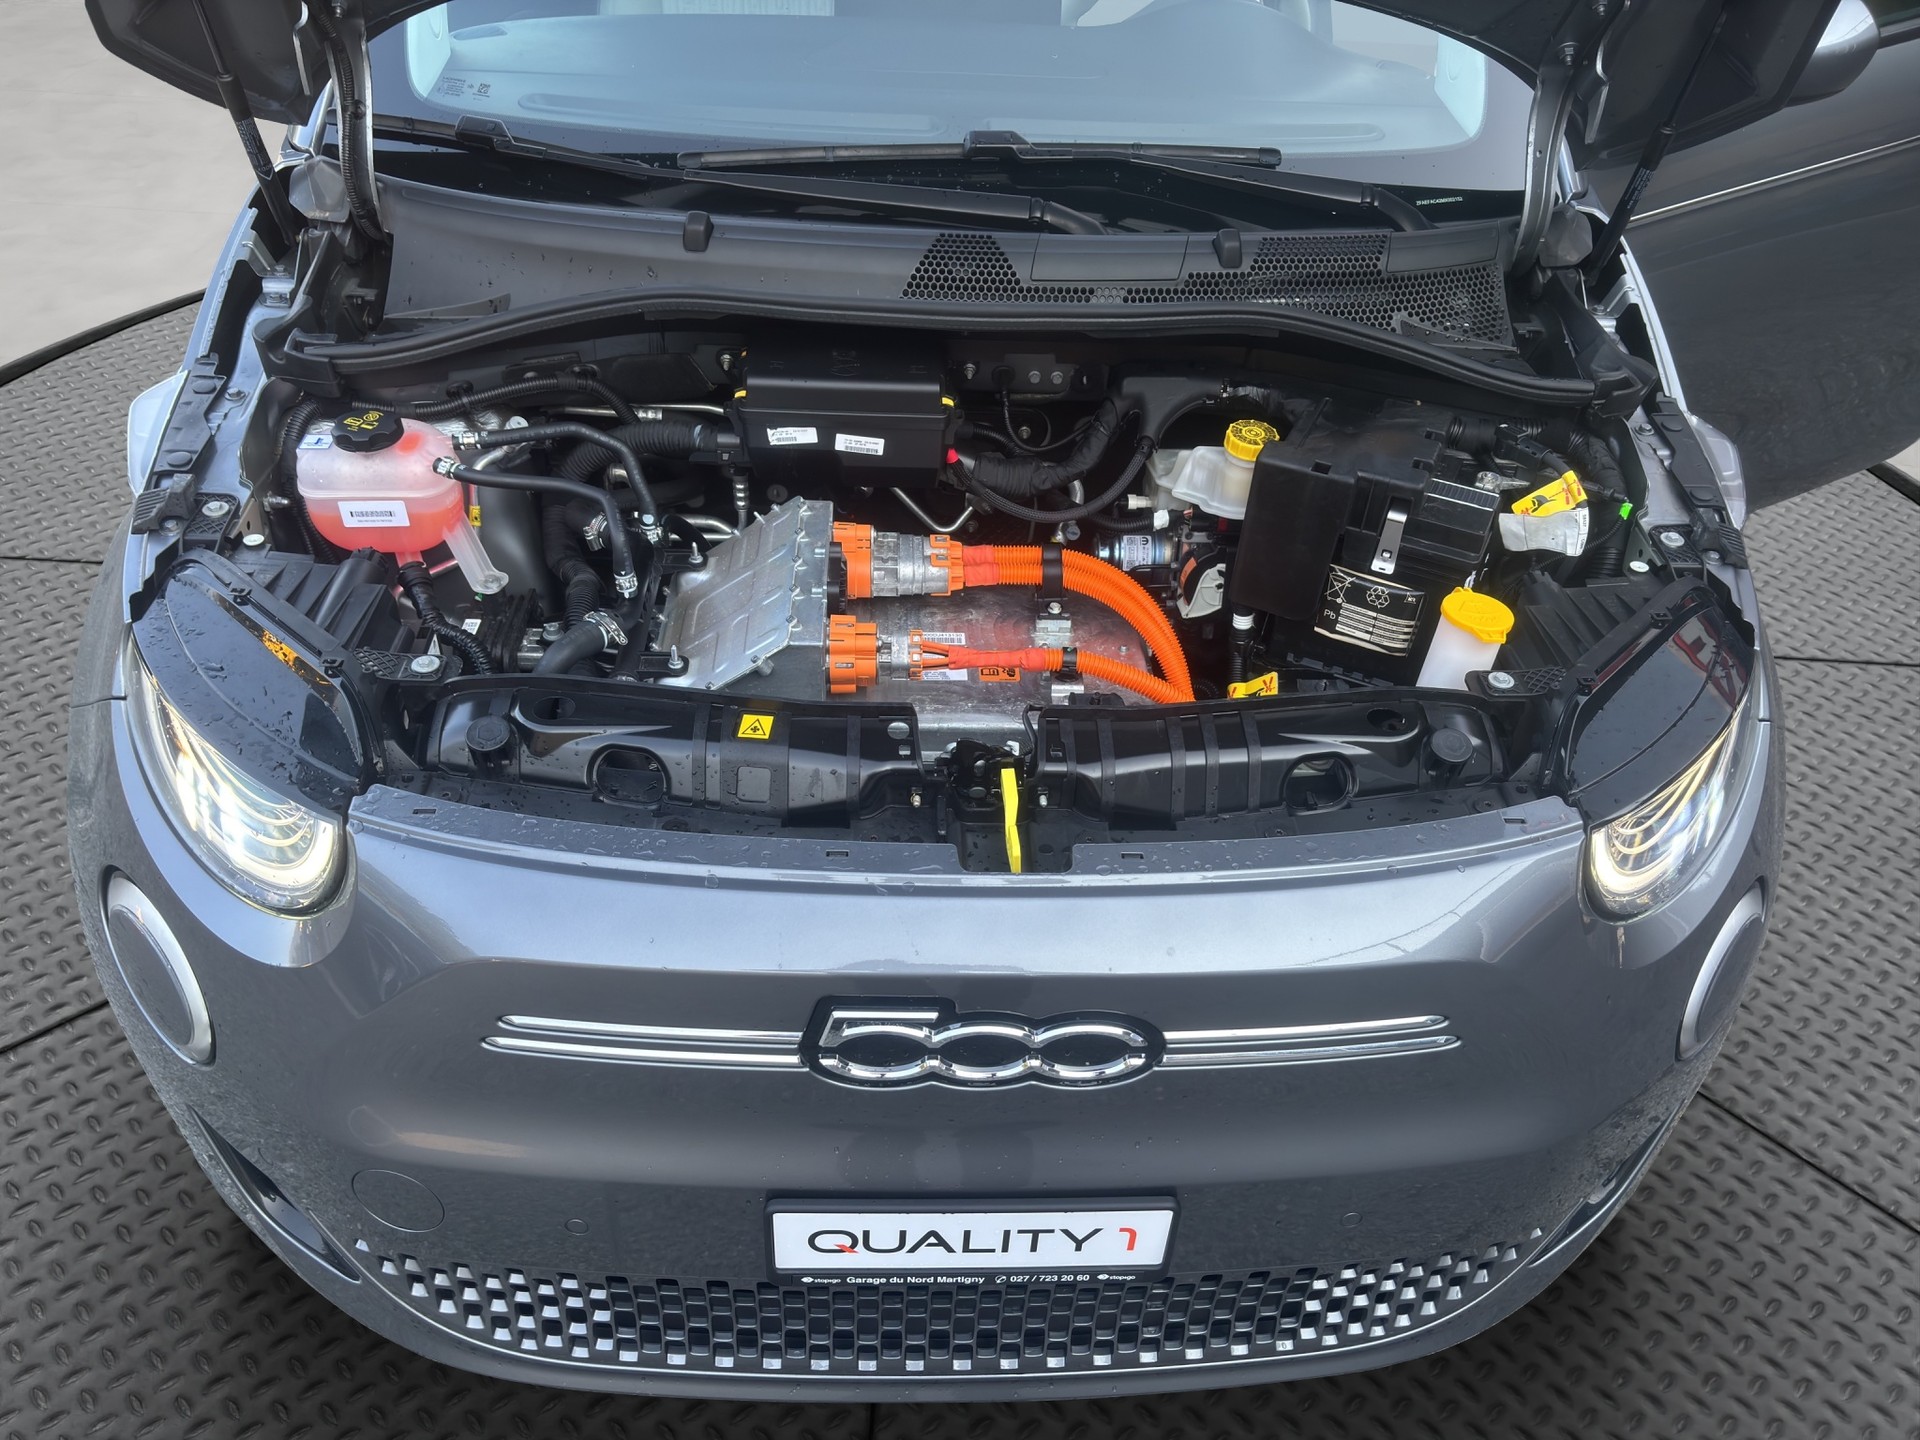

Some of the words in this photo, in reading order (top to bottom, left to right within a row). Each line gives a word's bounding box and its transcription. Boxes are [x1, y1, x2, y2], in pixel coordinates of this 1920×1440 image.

[1323, 608, 1336, 620] Pb
[818, 1009, 1148, 1078] 500
[807, 1228, 1104, 1254] QUALITY
[1119, 1227, 1137, 1251] 1
[846, 1276, 887, 1285] Garage
[889, 1276, 904, 1284] du
[937, 1276, 985, 1284] Martigny
[1010, 1275, 1030, 1283] 027
[1060, 1274, 1074, 1282] 20
[1076, 1274, 1090, 1282] 60
